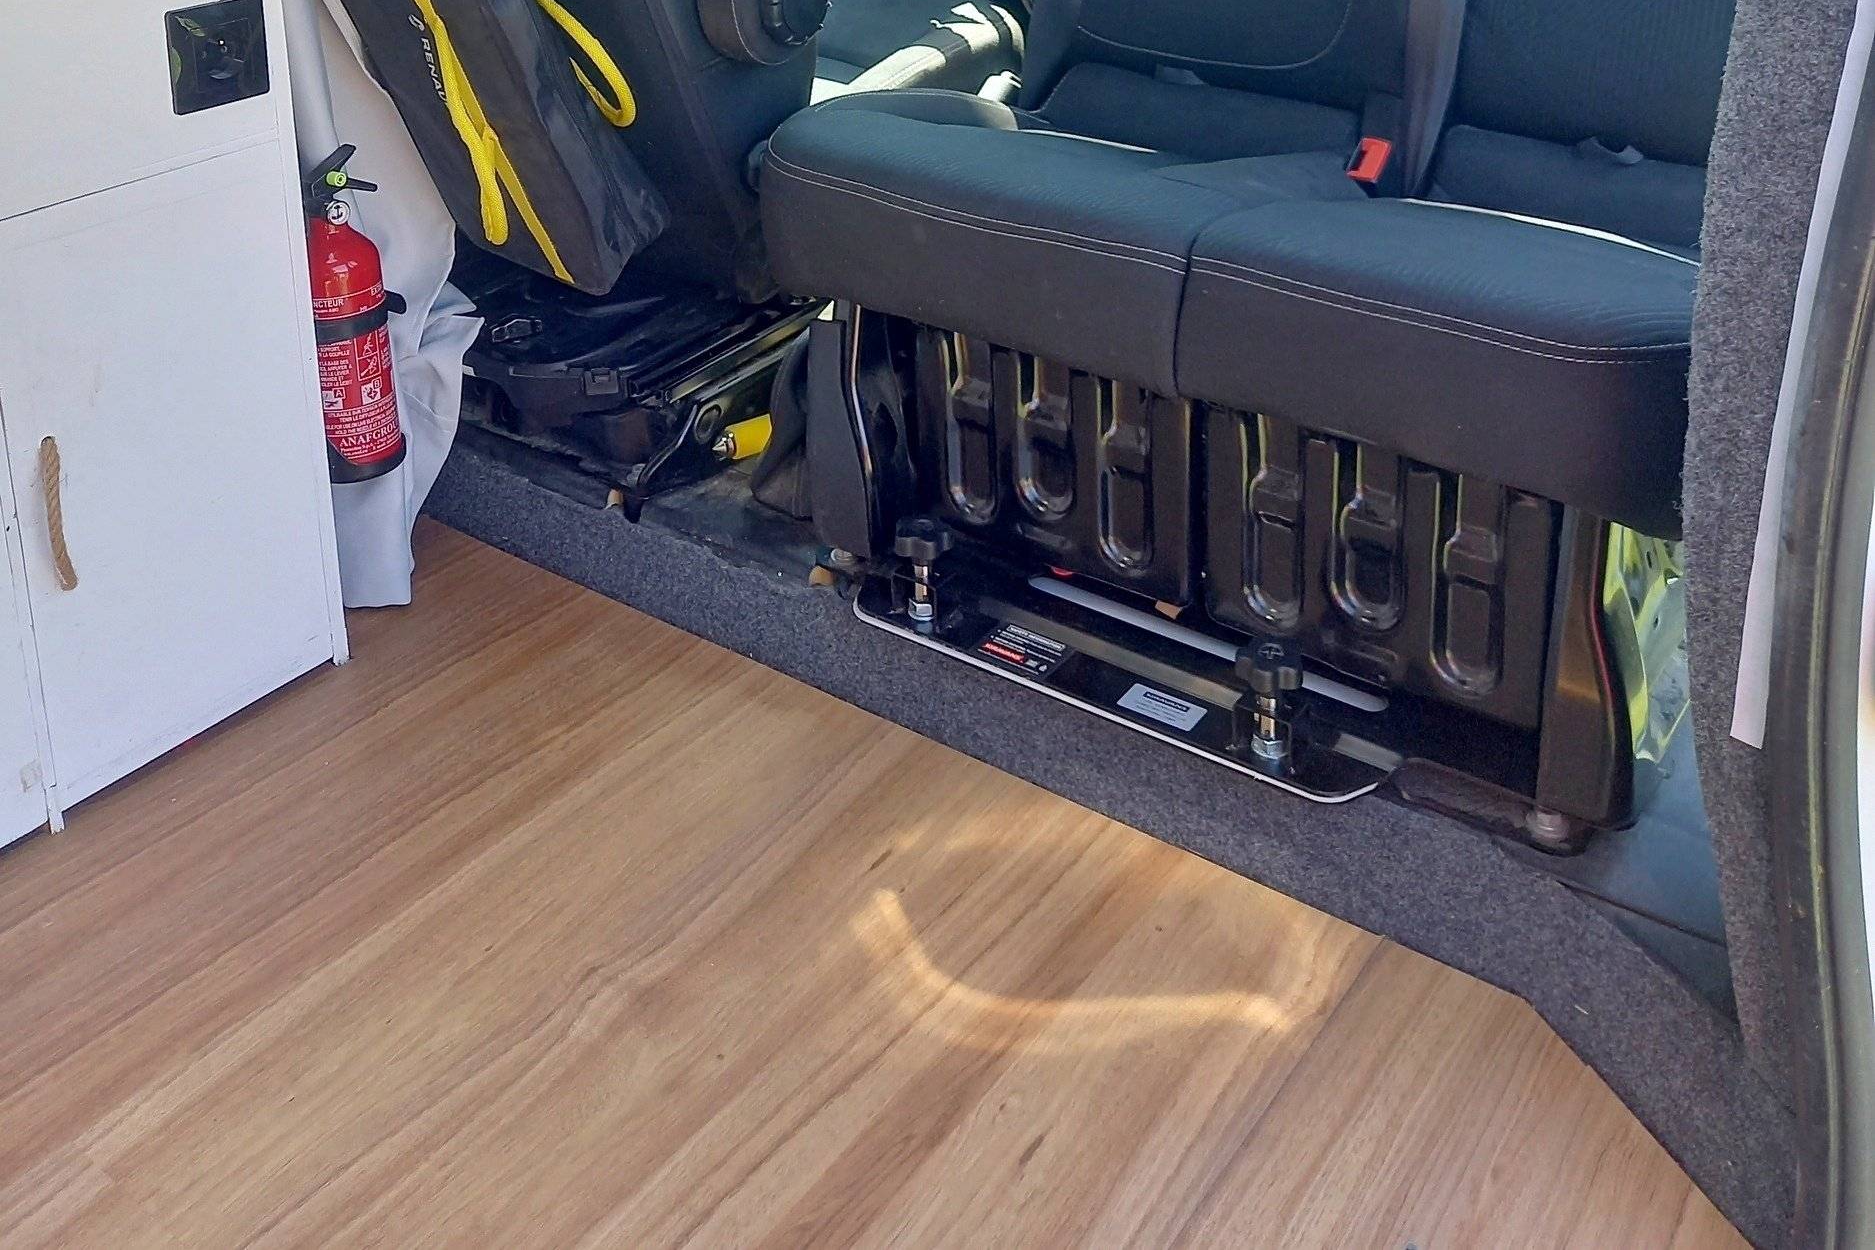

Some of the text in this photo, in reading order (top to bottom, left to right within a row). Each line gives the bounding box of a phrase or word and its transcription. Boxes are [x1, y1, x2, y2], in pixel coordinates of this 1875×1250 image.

[421, 36, 448, 107] RENAU
[313, 298, 345, 308] NCTEUR
[335, 390, 344, 398] A
